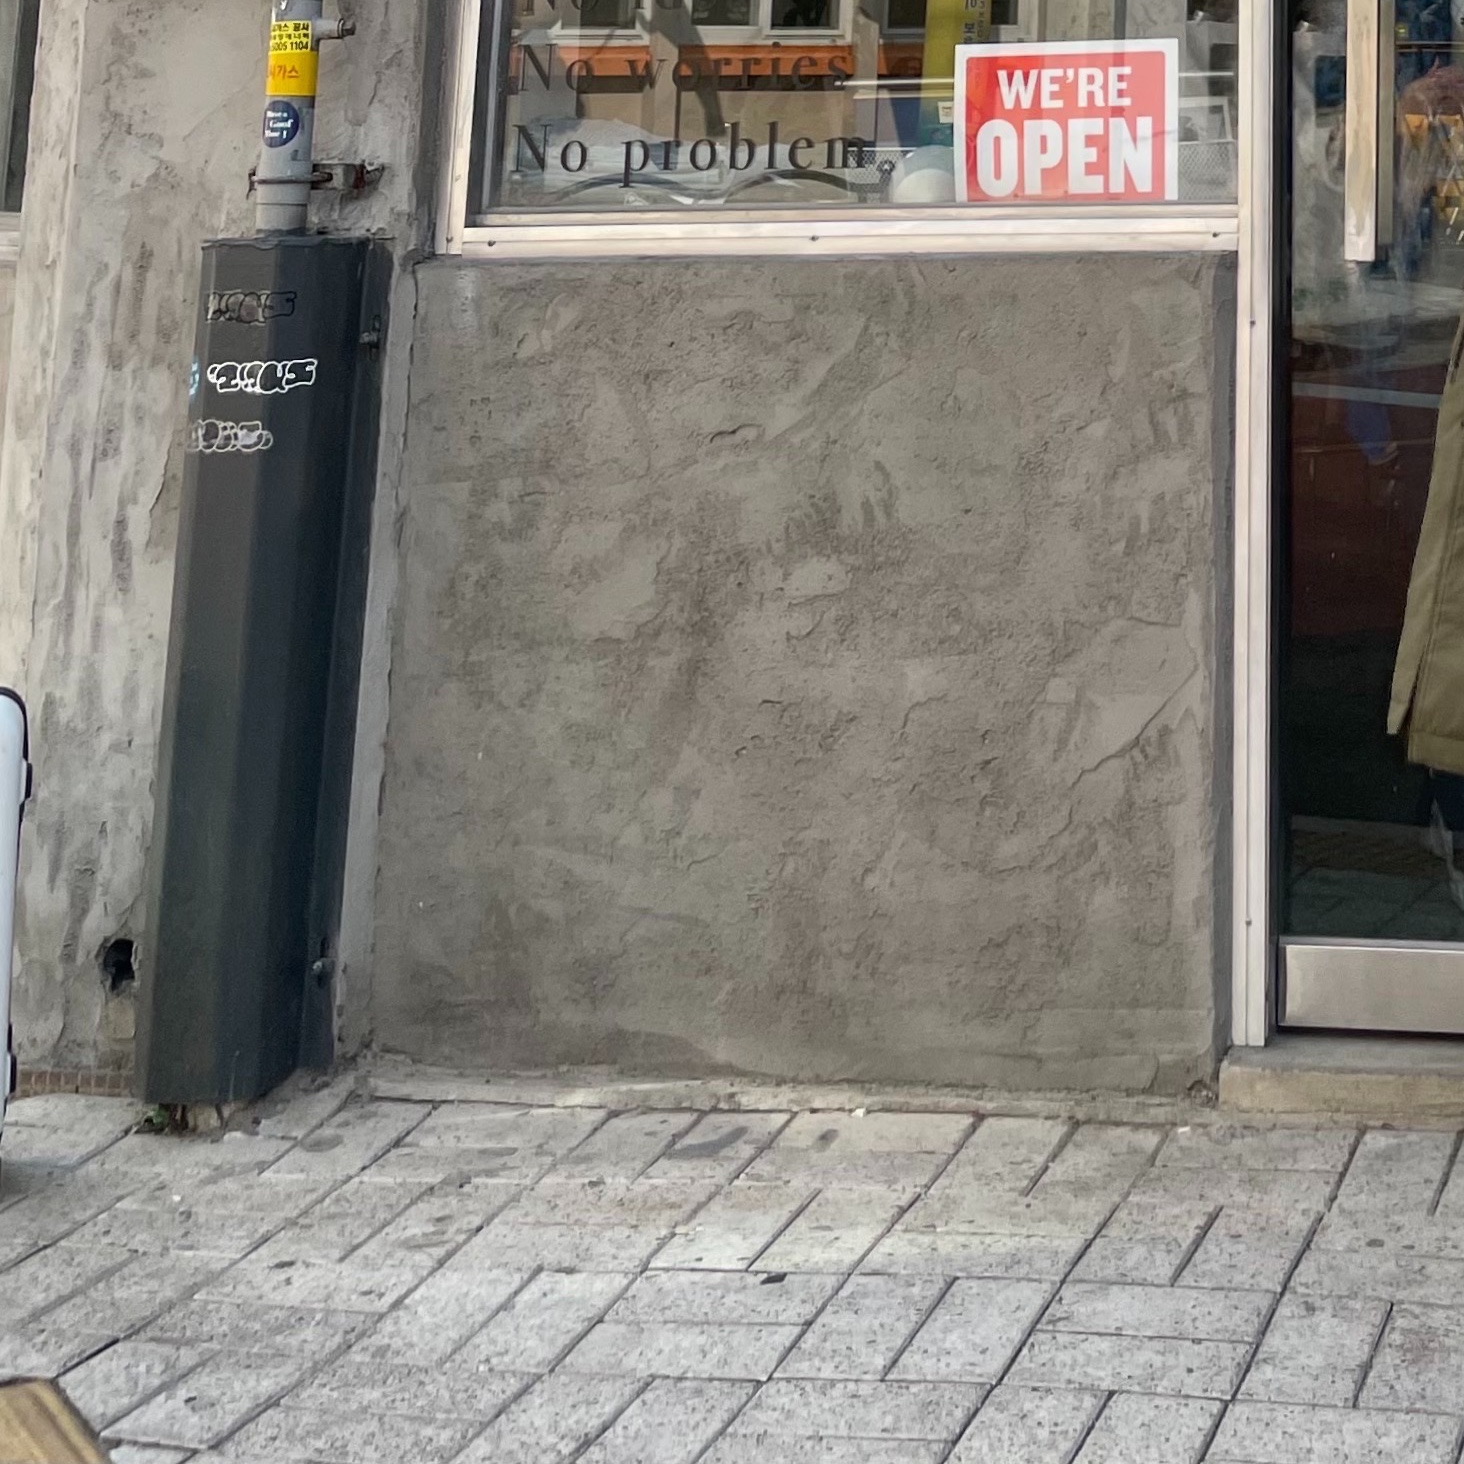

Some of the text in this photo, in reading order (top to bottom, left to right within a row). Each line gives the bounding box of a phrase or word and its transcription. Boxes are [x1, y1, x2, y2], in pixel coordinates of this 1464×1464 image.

[518, 41, 848, 92] No worries
[997, 66, 1132, 110] WE'RE
[511, 121, 867, 188] No problem
[976, 116, 1152, 197] OPEN
